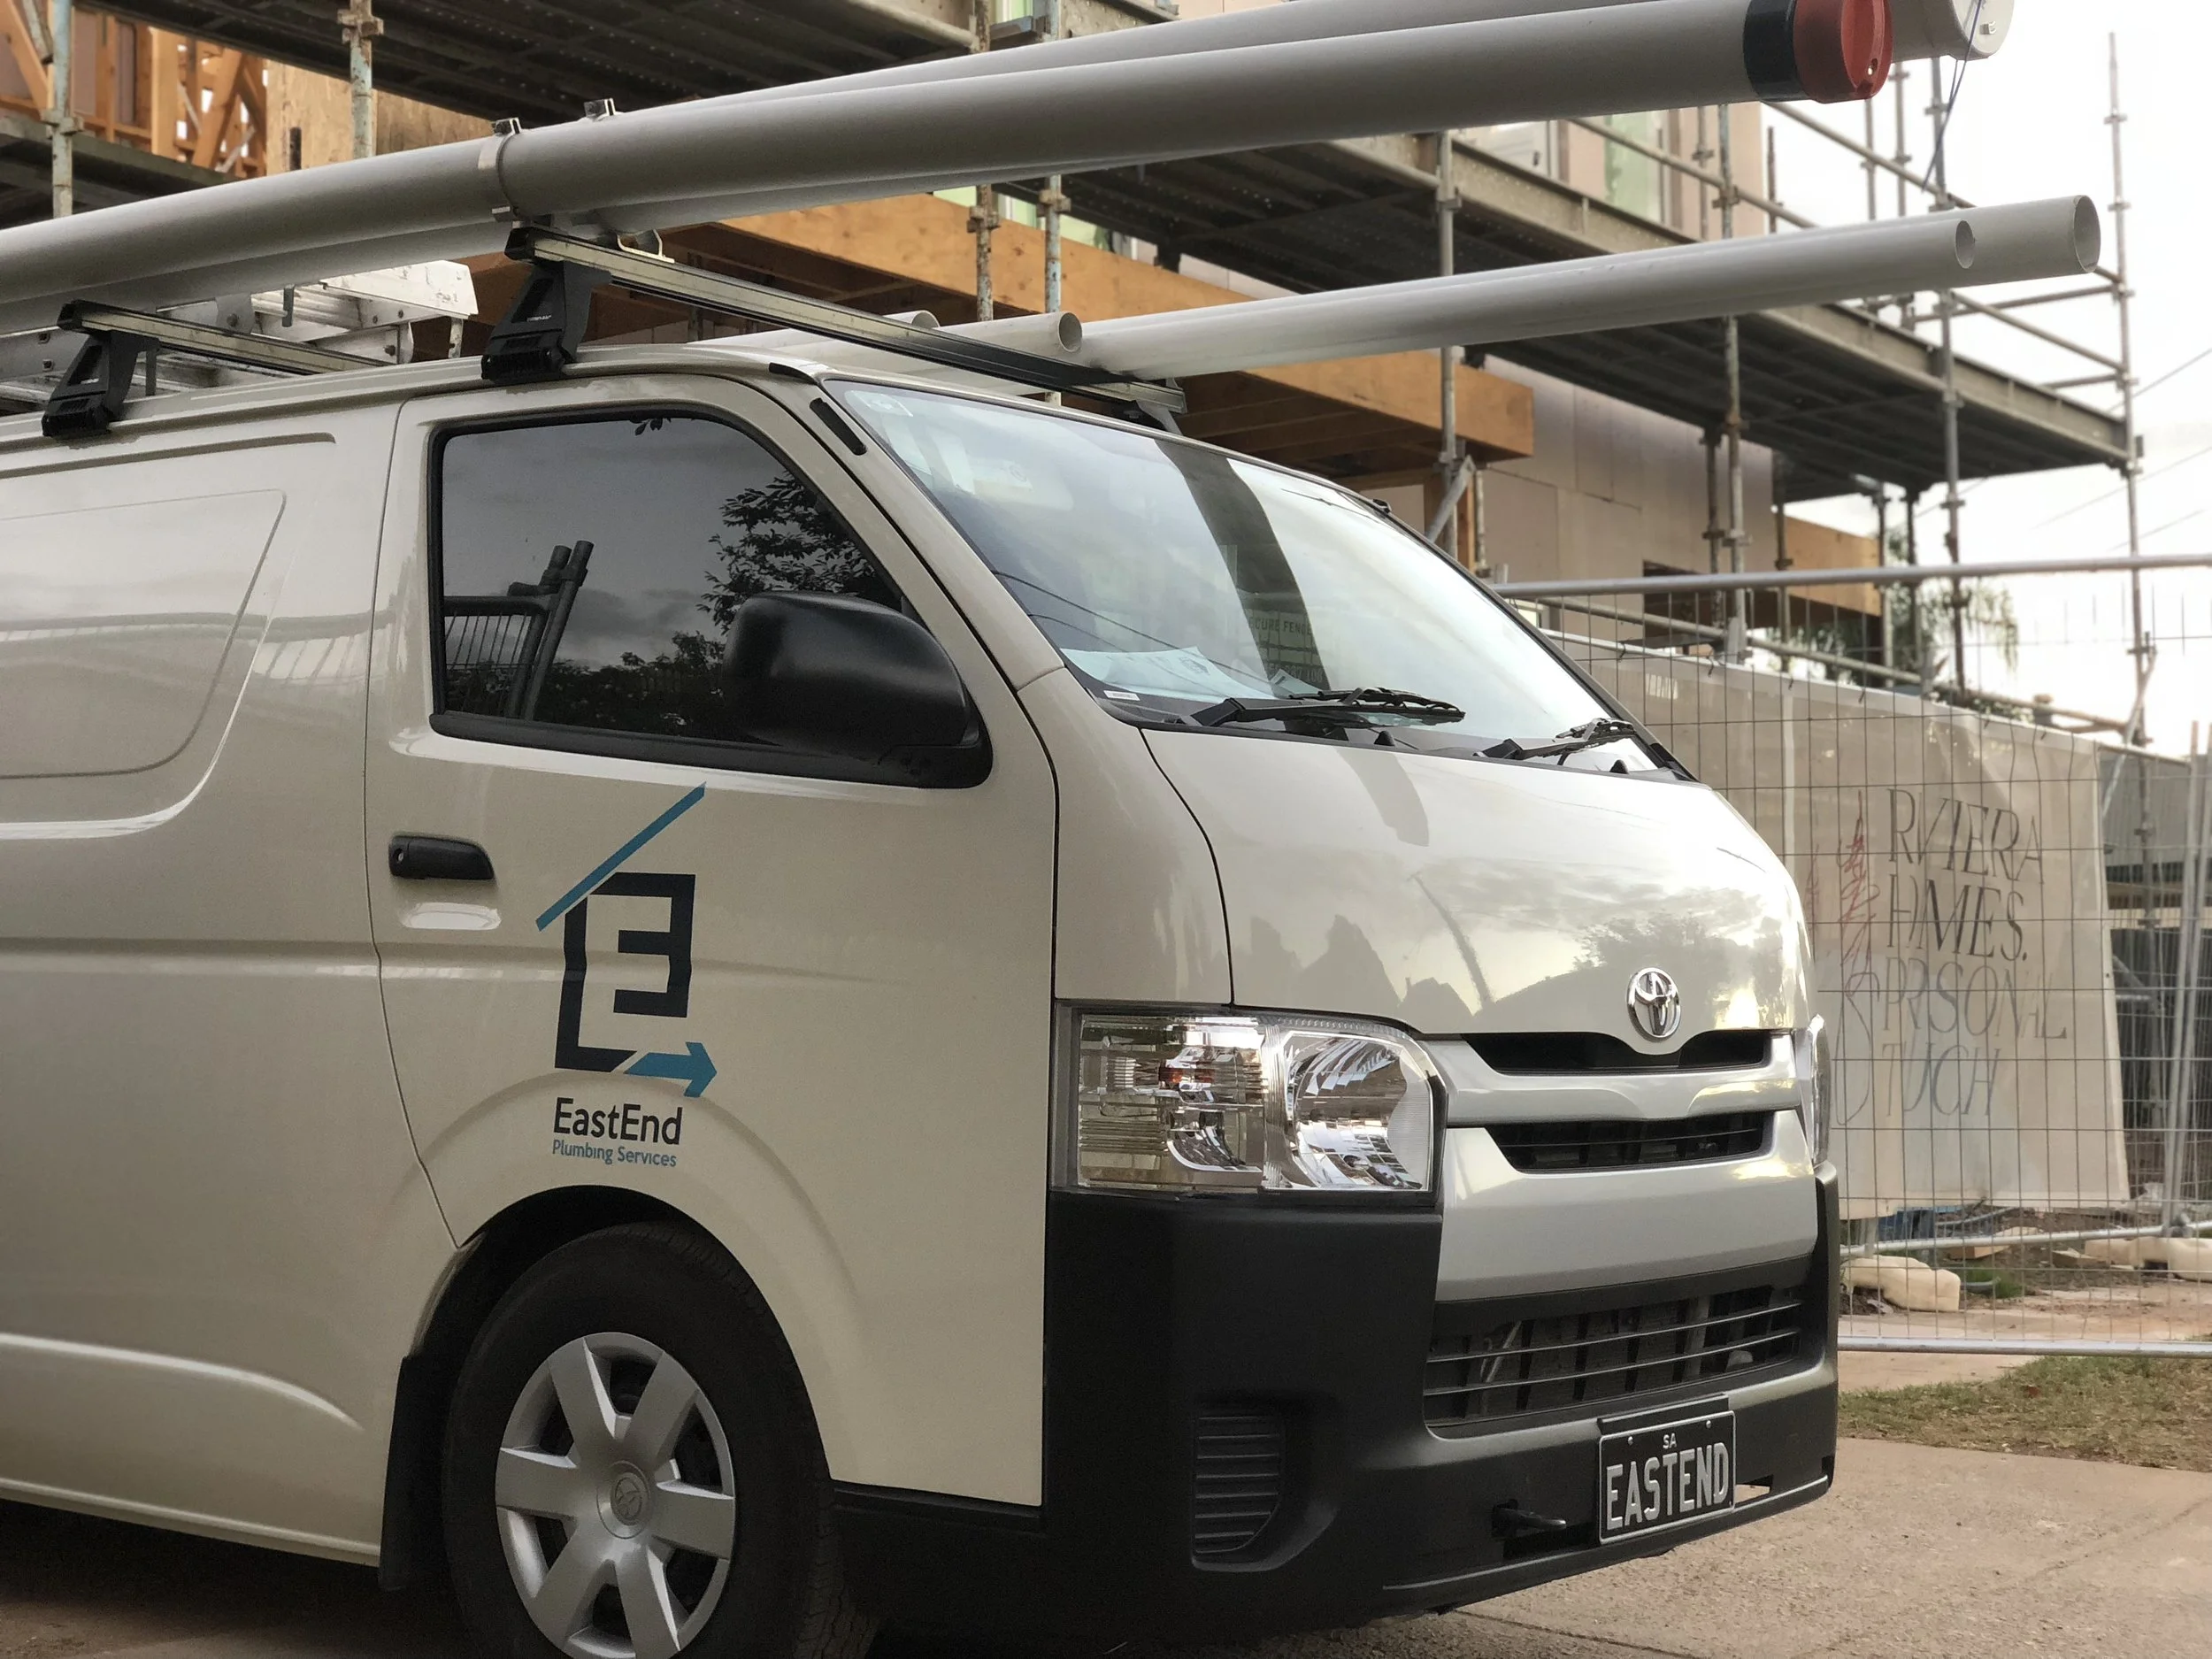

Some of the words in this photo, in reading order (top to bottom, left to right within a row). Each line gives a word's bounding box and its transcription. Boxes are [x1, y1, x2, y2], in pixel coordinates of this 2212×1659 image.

[1886, 788, 2045, 885] RVIERA
[553, 1096, 684, 1146] EastEnd
[552, 1139, 613, 1165] Plumbing
[617, 1146, 677, 1167] Services
[1662, 1432, 1678, 1449] SA
[1606, 1441, 1729, 1531] EASTEND
